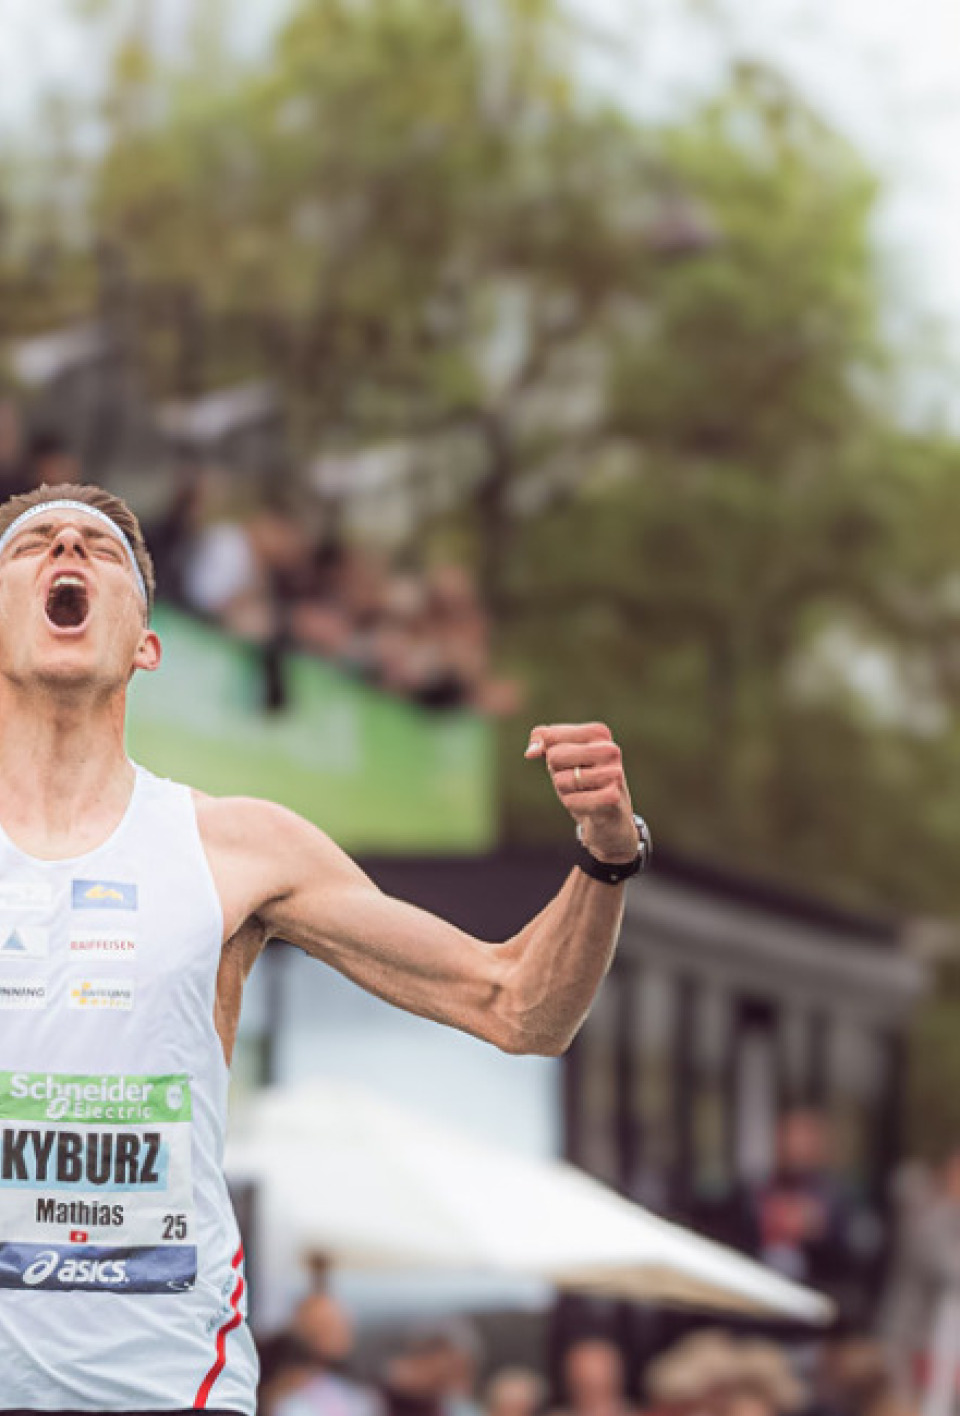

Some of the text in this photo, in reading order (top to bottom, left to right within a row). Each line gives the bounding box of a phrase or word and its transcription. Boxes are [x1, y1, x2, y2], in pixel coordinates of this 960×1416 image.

[70, 940, 135, 950] RAIFFEISEN
[10, 1073, 154, 1103] Schneider
[74, 1105, 152, 1119] Electric
[1, 1128, 161, 1185] KYBURZ
[36, 1198, 124, 1226] Mathias
[161, 1214, 187, 1240] 25
